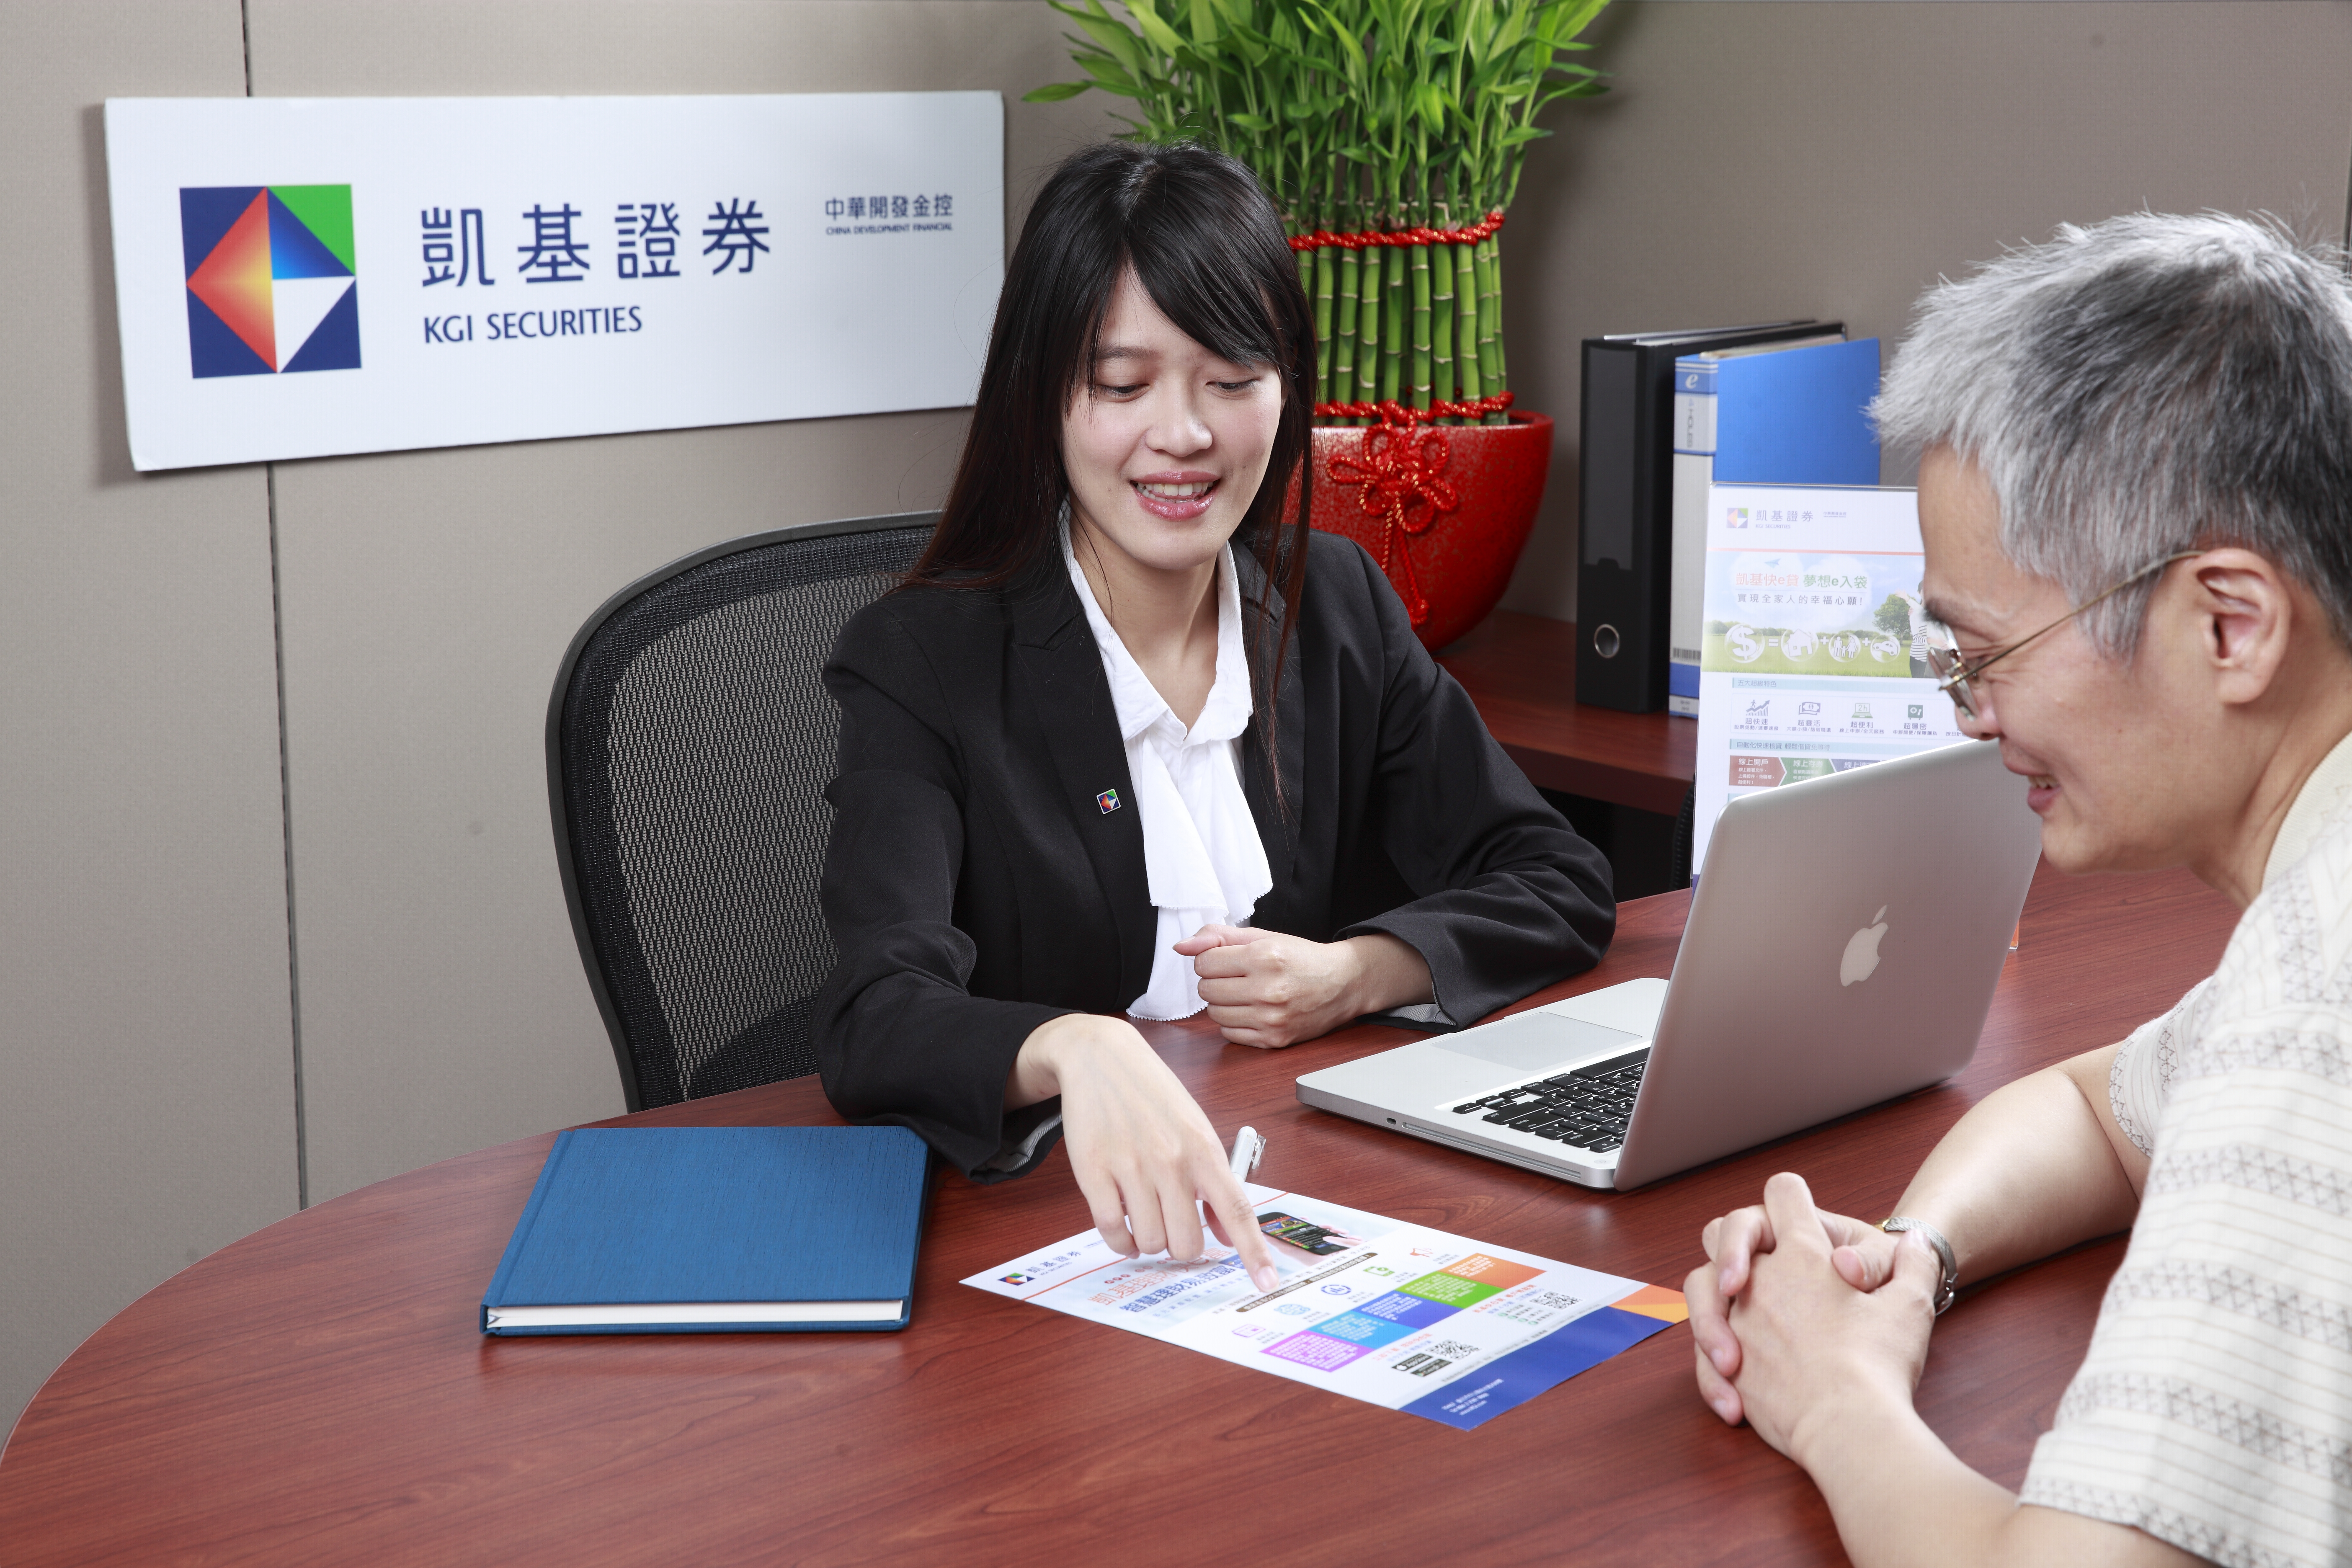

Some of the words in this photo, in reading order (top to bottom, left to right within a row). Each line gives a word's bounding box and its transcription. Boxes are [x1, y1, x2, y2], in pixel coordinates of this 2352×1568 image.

[825, 193, 953, 221] 中華開發金控
[825, 226, 851, 235] CHINA
[853, 224, 910, 234] DEVELOPMENT
[913, 222, 953, 232] FINANCIAL
[420, 197, 770, 288] 凱基證券
[424, 315, 473, 343] KGI
[487, 306, 642, 340] SECURITIES
[1756, 510, 1813, 522] 凱基證券
[1736, 573, 1799, 587] 凱基快e貸
[1803, 574, 1867, 589] 夢想e入袋
[1738, 679, 1777, 688] 五大超級特色
[1736, 741, 1782, 750] 自動化快速核貸
[1025, 1251, 1081, 1273] 凱基證券
[1119, 1266, 1236, 1313] 智慧理財易致富
